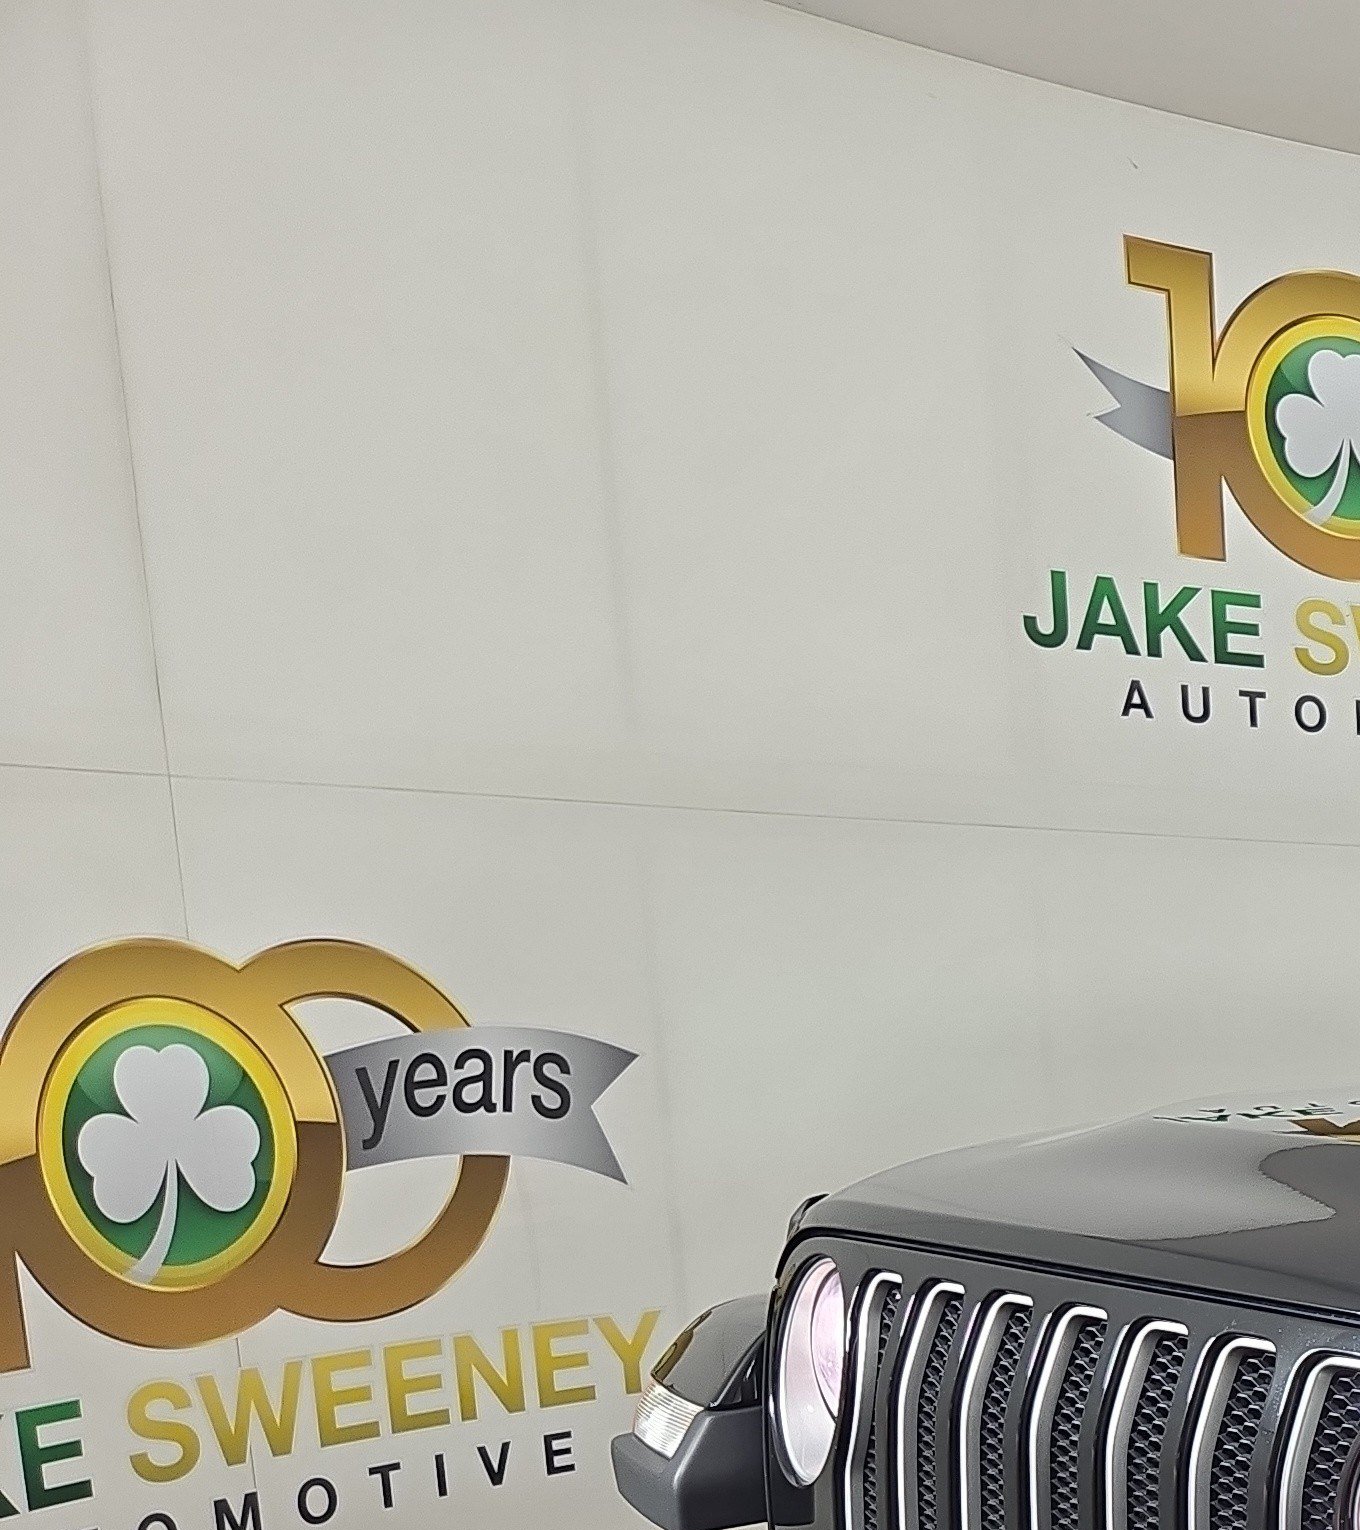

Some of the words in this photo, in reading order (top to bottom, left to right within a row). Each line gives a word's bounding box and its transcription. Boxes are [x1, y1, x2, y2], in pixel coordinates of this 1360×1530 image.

[1023, 569, 1266, 669] JAKE
[354, 1048, 573, 1151] years
[126, 1310, 662, 1484] SWEENEY
